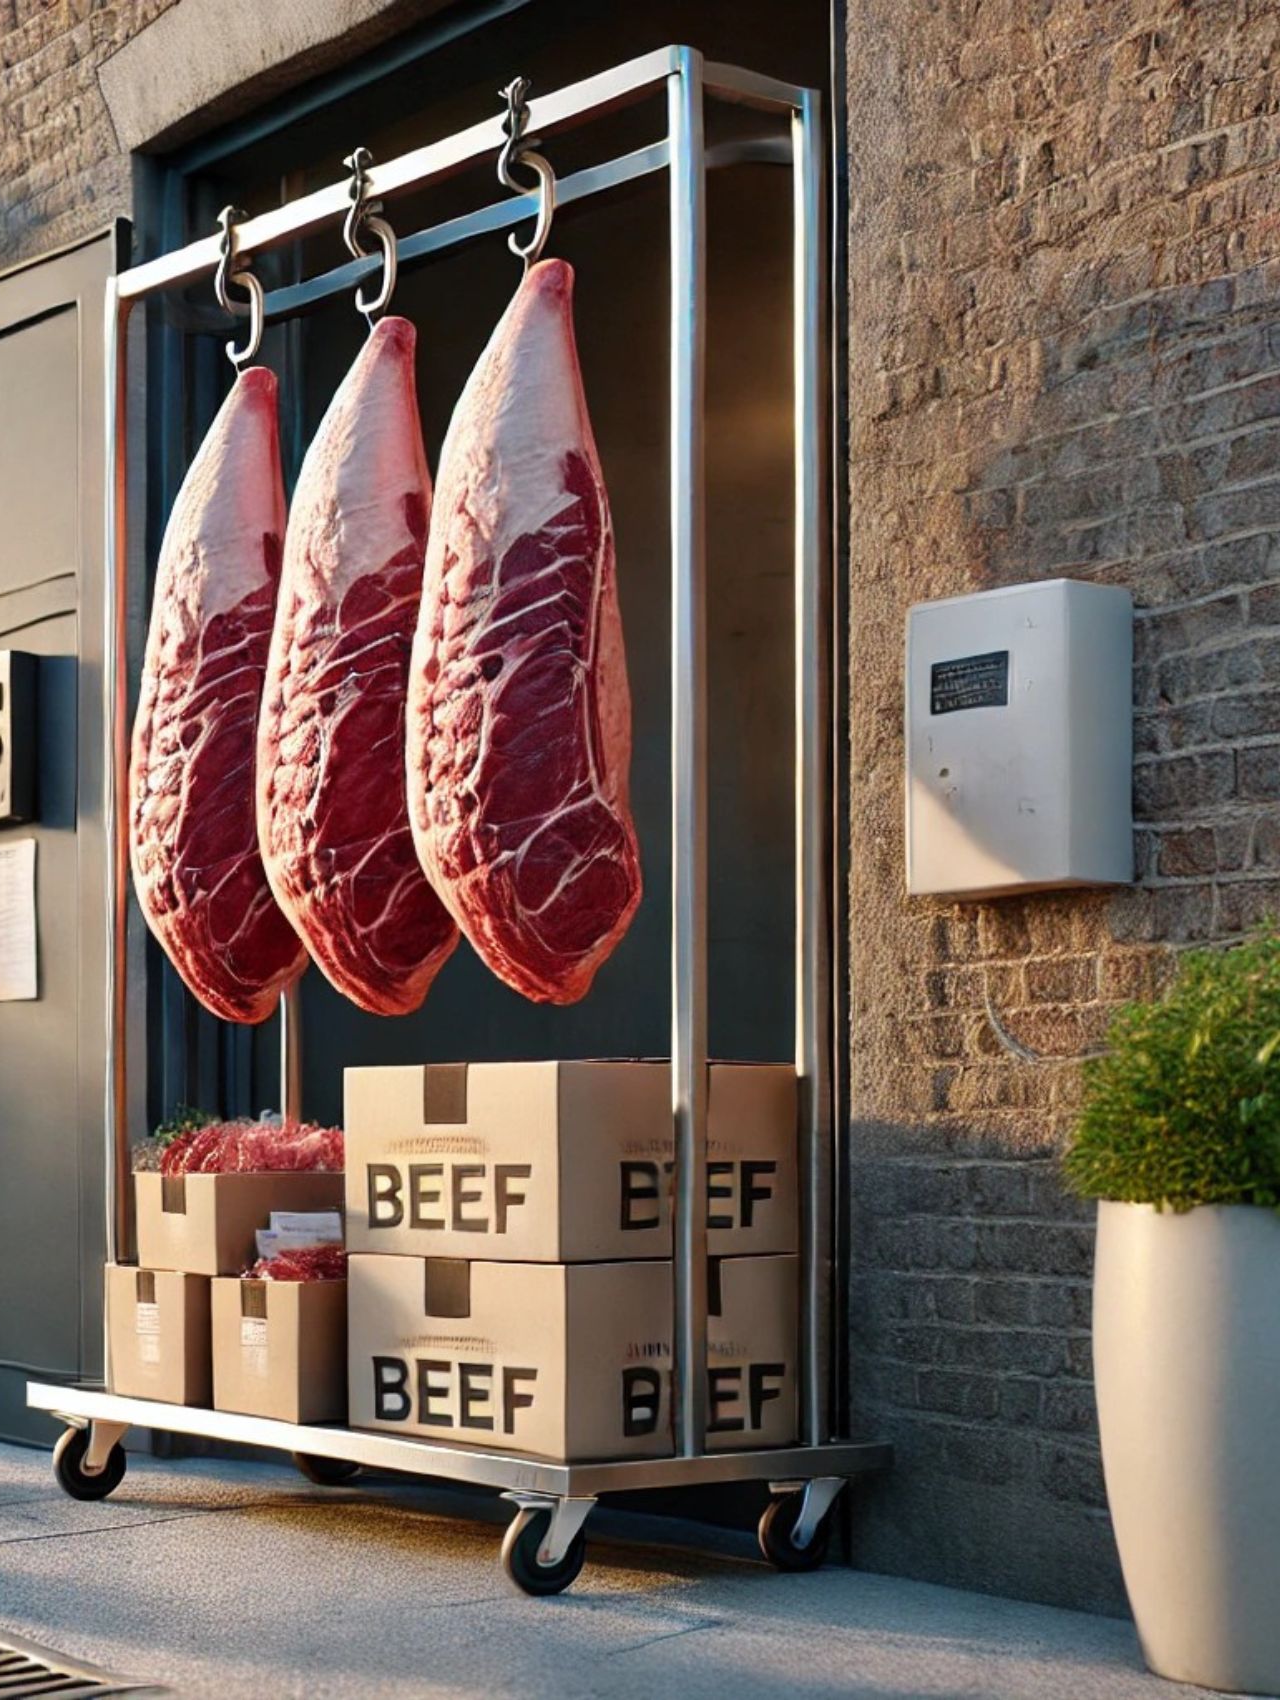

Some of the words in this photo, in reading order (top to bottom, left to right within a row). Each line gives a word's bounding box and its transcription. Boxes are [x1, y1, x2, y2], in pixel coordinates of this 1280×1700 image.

[366, 1163, 533, 1234] BEEF
[620, 1159, 777, 1230] BEF
[372, 1356, 539, 1435] BEEF
[622, 1363, 786, 1437] BEF
